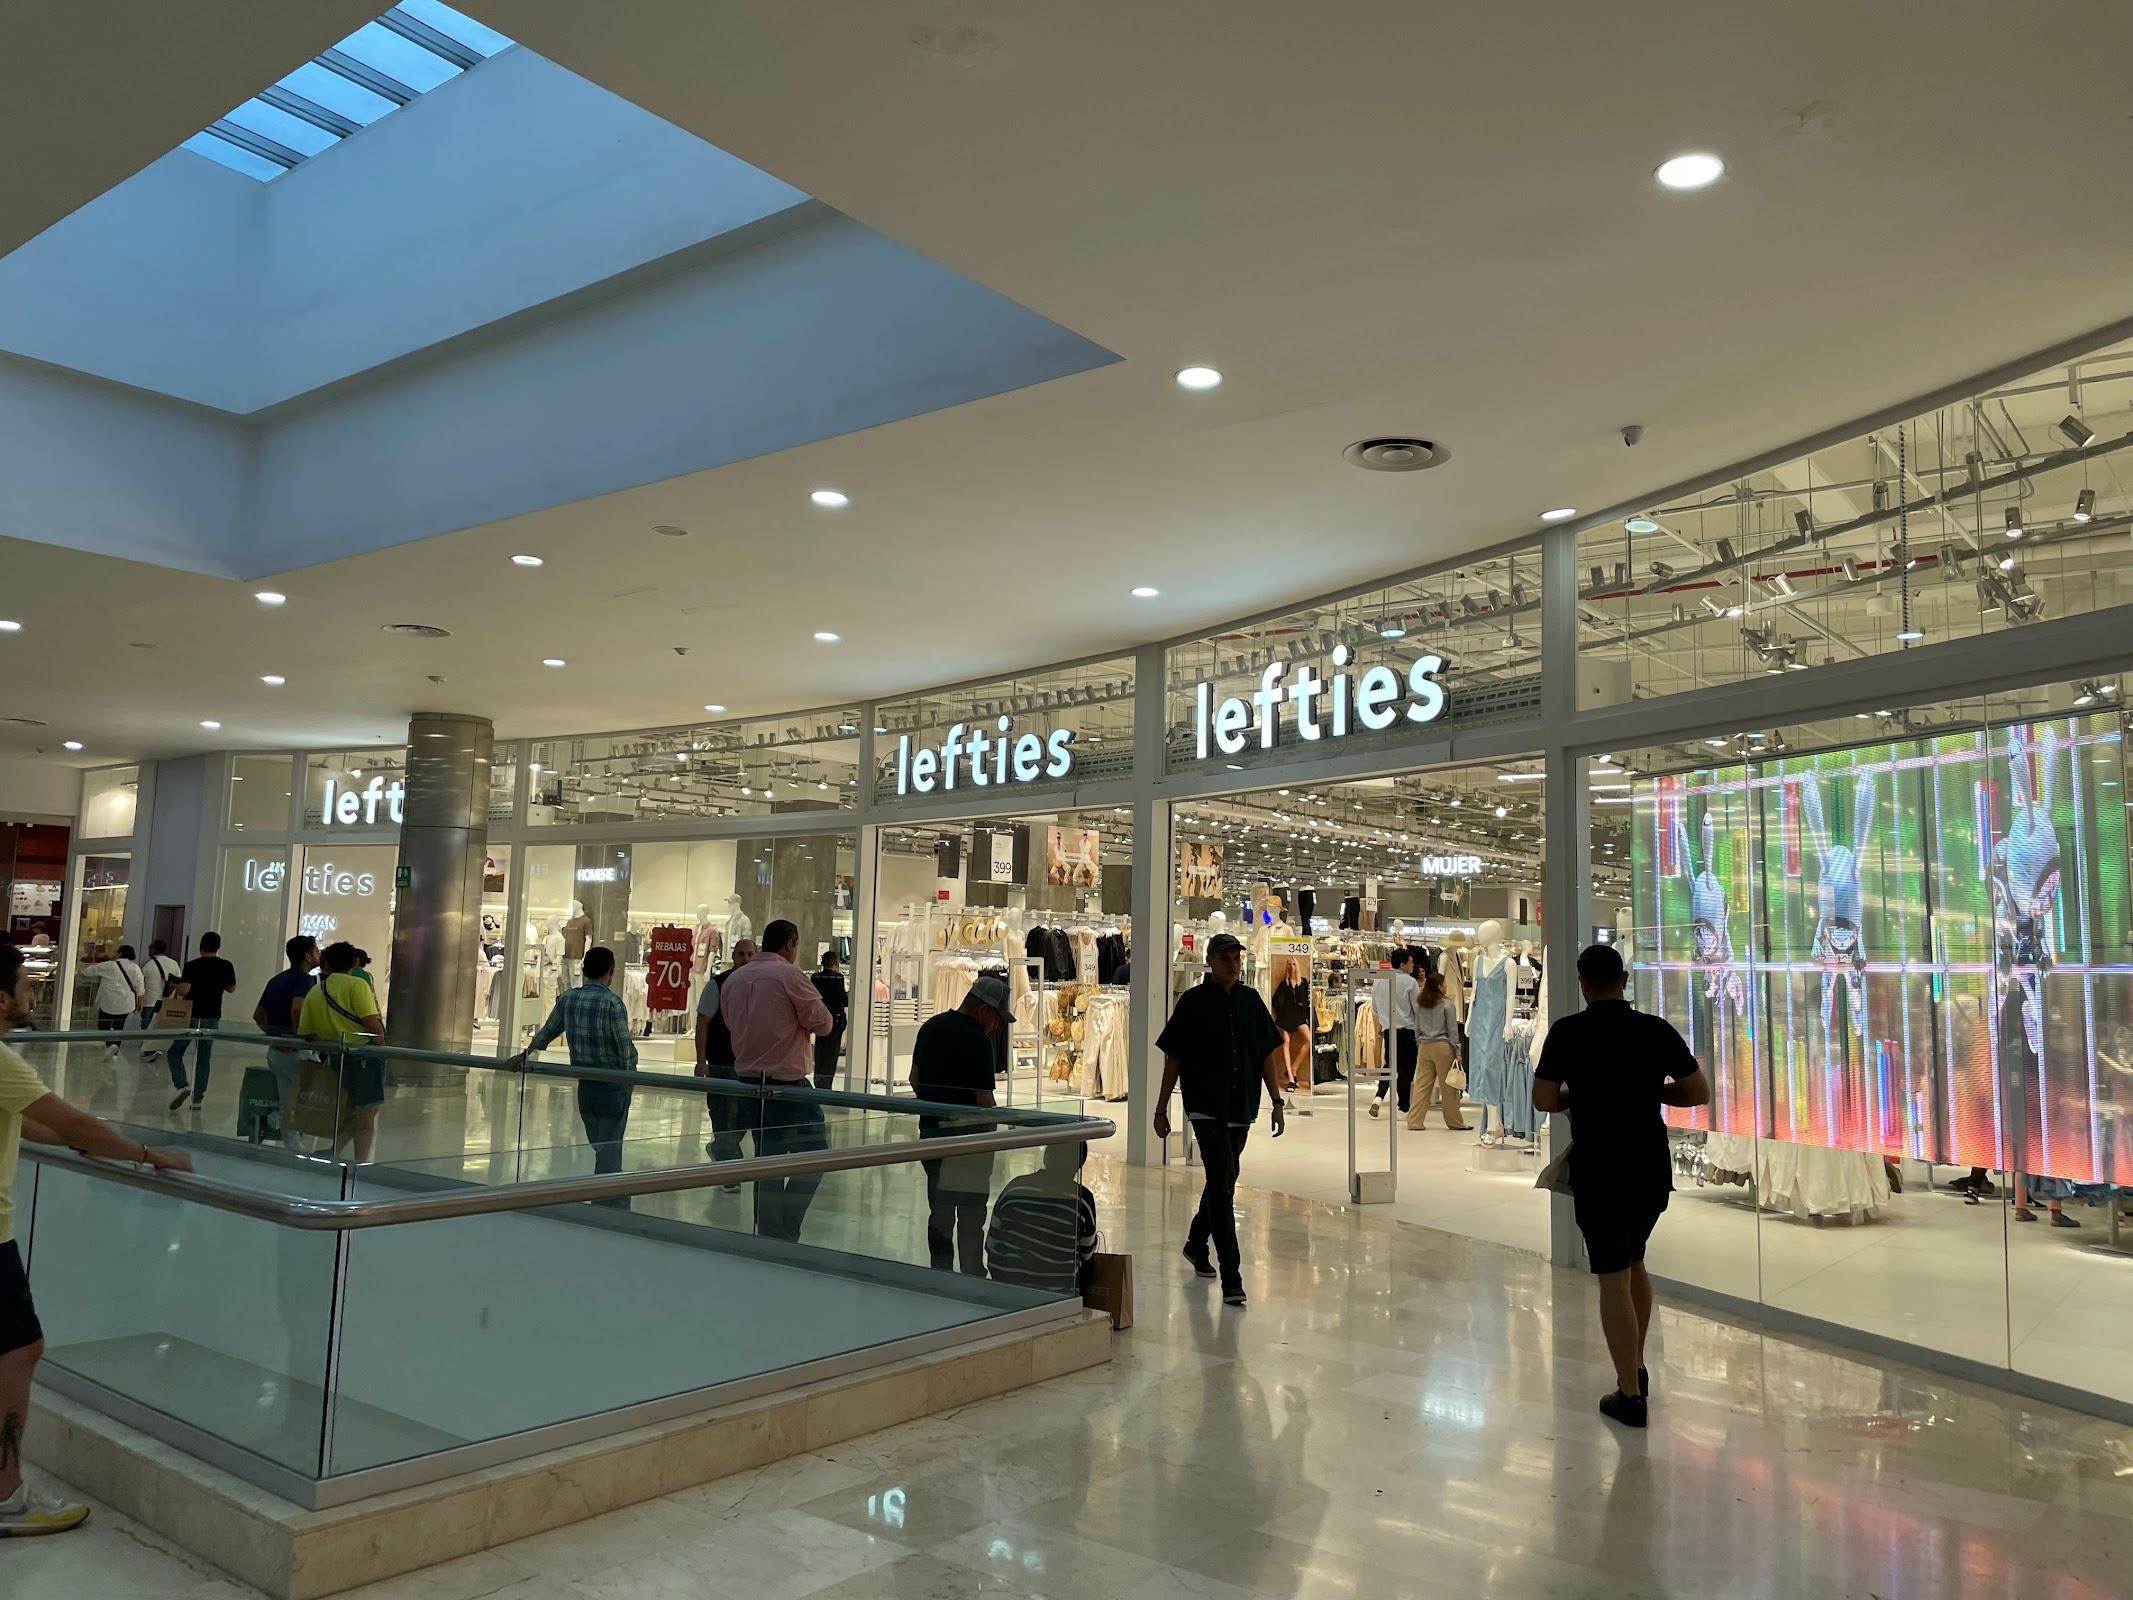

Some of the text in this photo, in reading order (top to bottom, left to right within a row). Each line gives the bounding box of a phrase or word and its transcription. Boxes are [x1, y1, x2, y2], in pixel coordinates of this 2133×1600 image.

[1196, 644, 1447, 759] lefties
[898, 714, 1075, 795] lefties
[322, 776, 405, 825] left
[993, 861, 1012, 874] 399
[1423, 856, 1482, 874] MUJER
[245, 859, 374, 896] leties
[577, 867, 616, 881] HOMBRE
[301, 914, 337, 930] MAN
[655, 941, 687, 952] REBAJAS
[1288, 943, 1309, 954] 349
